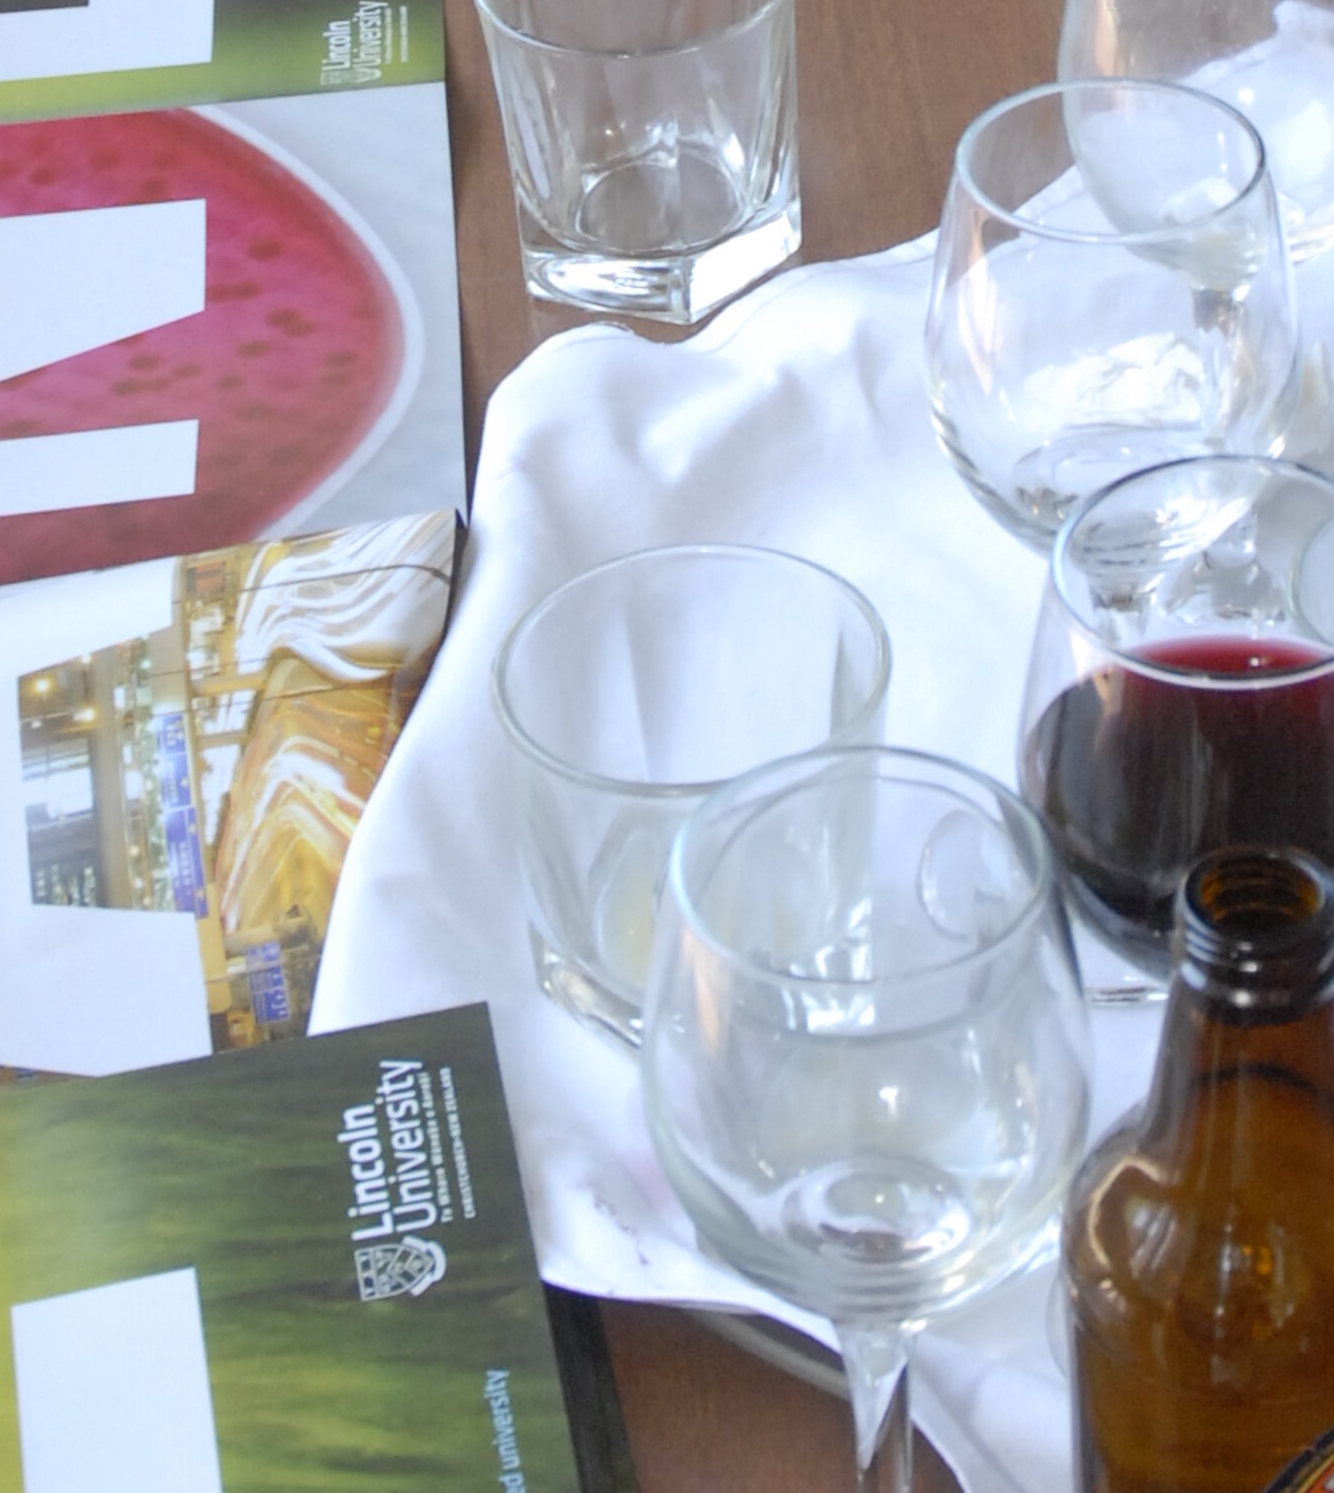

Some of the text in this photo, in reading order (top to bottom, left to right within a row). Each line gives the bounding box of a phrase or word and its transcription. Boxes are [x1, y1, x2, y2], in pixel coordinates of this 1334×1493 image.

[322, 20, 352, 71] Lincoln
[352, 0, 389, 83] University
[337, 1103, 394, 1242] Lincoln
[376, 1060, 437, 1233] University
[483, 1369, 522, 1472] university
